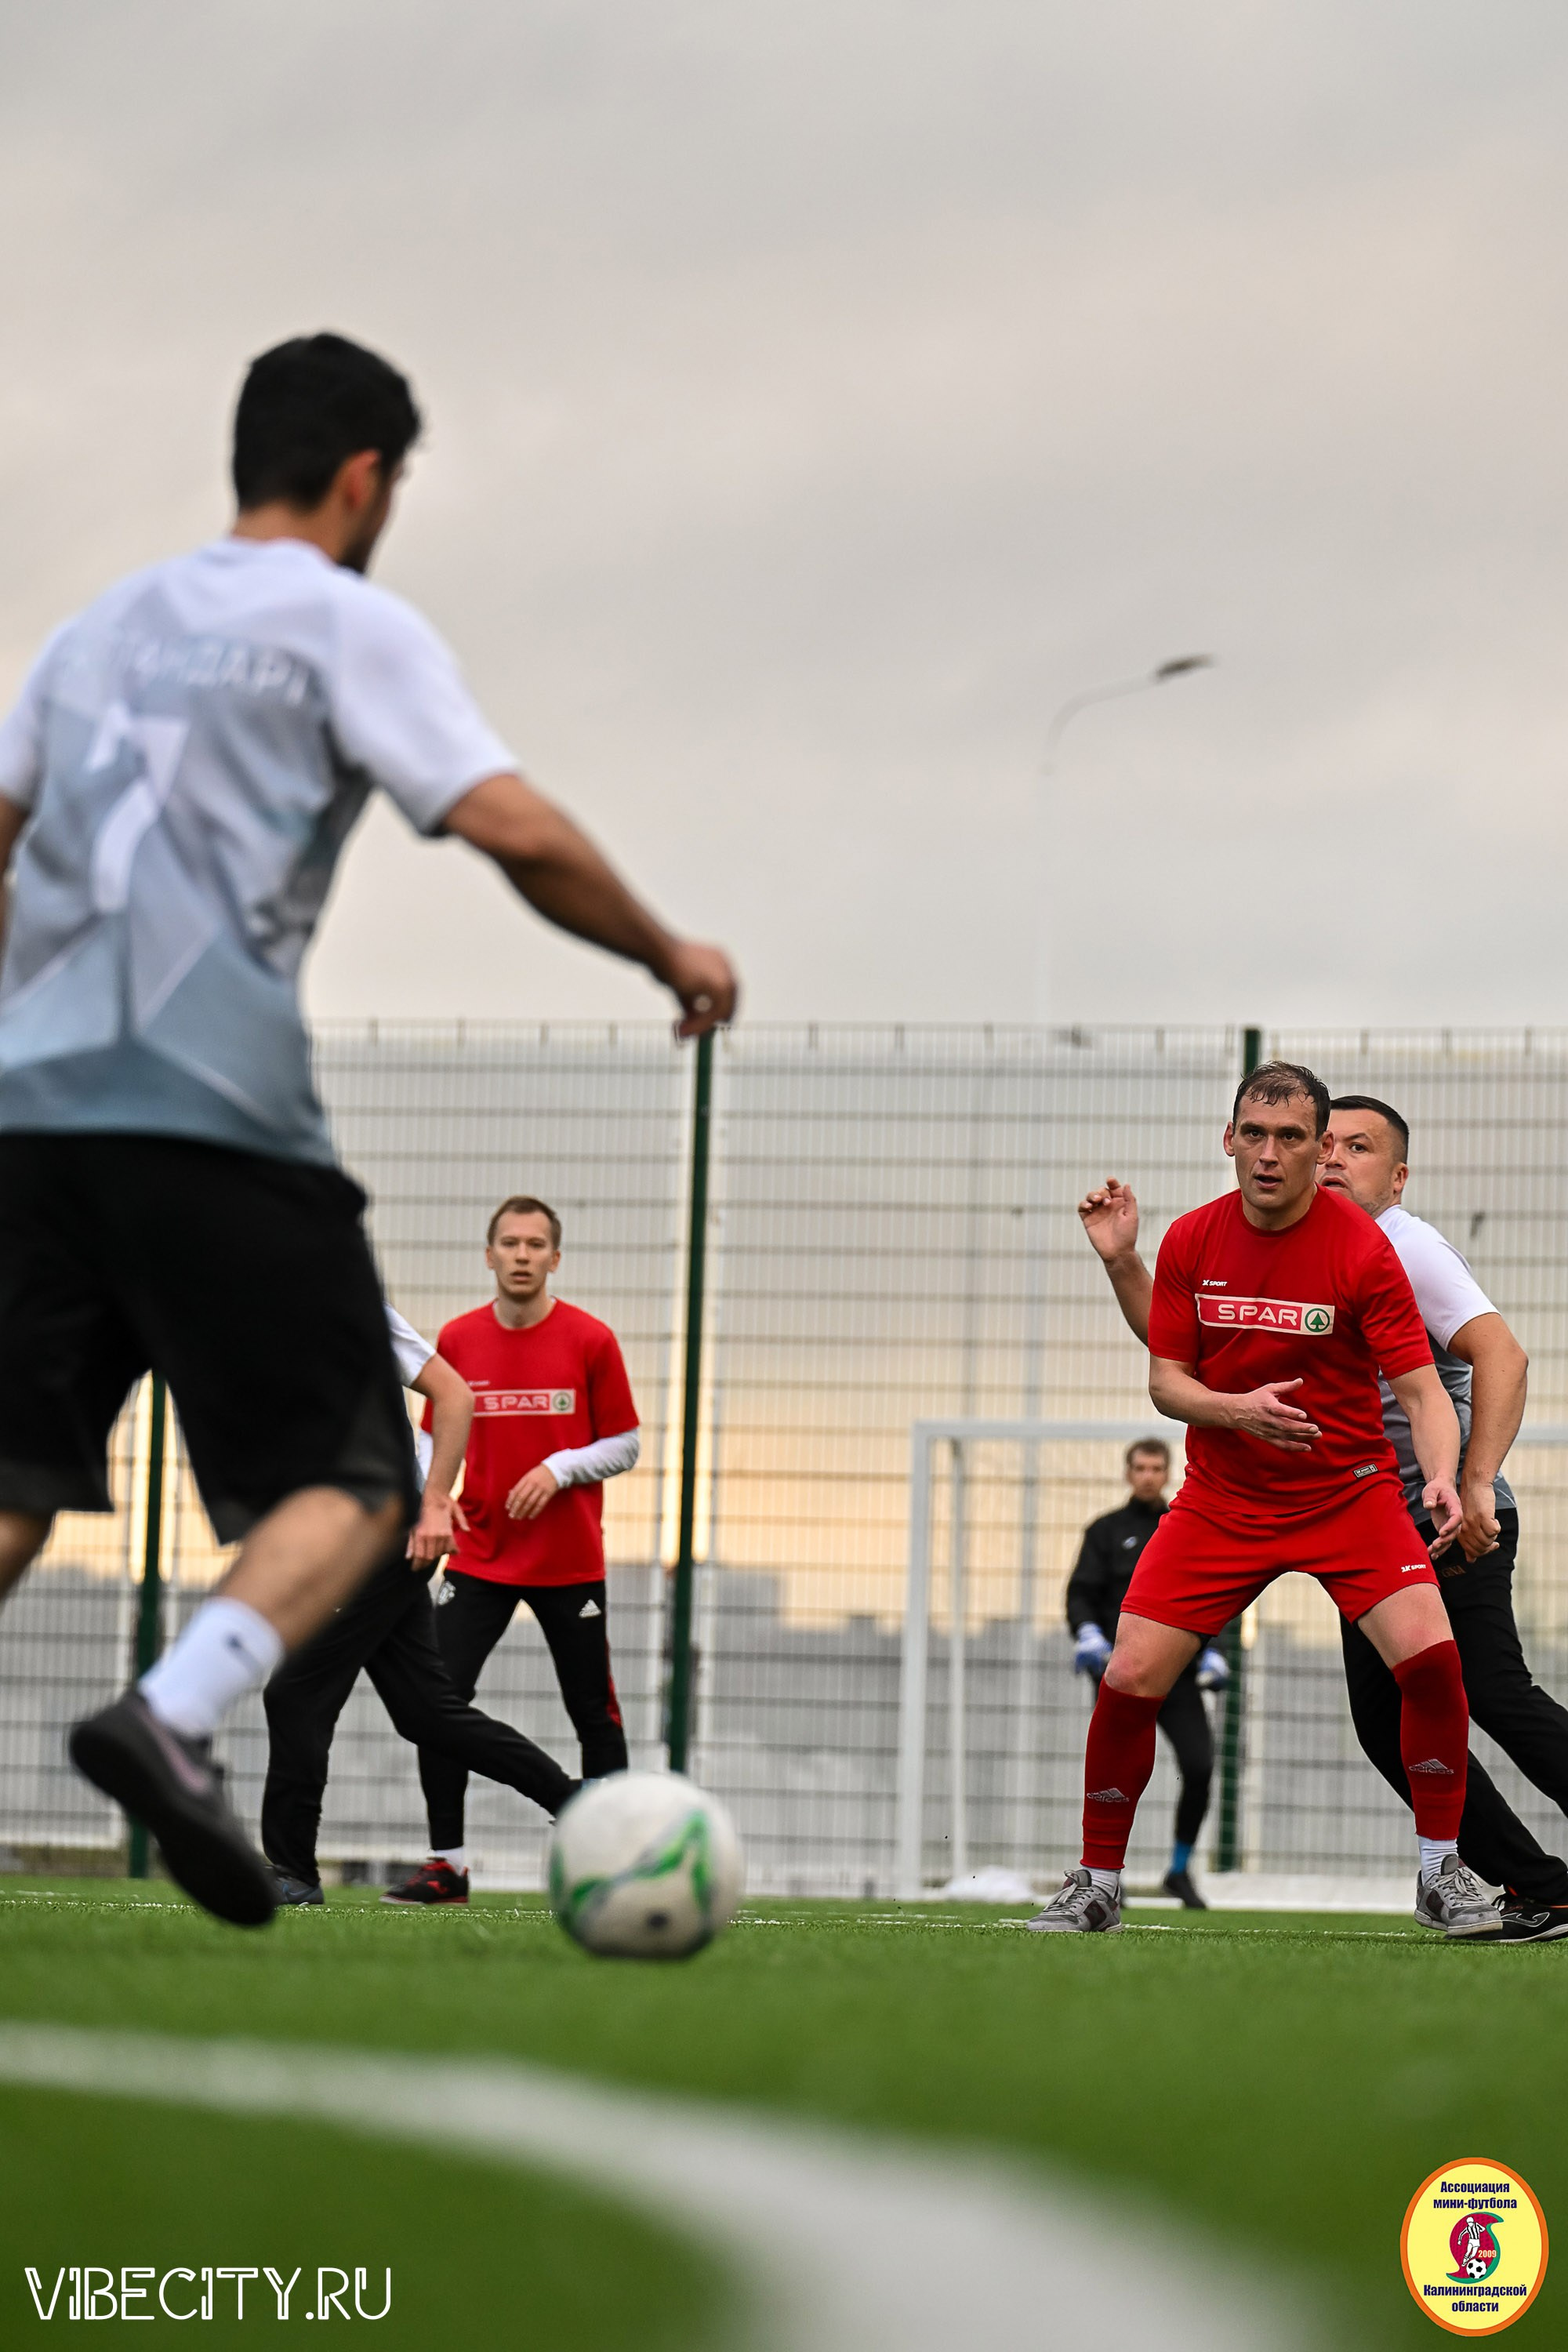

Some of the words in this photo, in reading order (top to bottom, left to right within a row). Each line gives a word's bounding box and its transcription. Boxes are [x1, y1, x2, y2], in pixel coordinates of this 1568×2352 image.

[85, 702, 191, 911] 7
[1218, 1304, 1298, 1327] SPAR
[484, 1396, 548, 1410] SPAR
[1408, 1763, 1454, 1774] adidas
[1087, 1792, 1129, 1802] adidas
